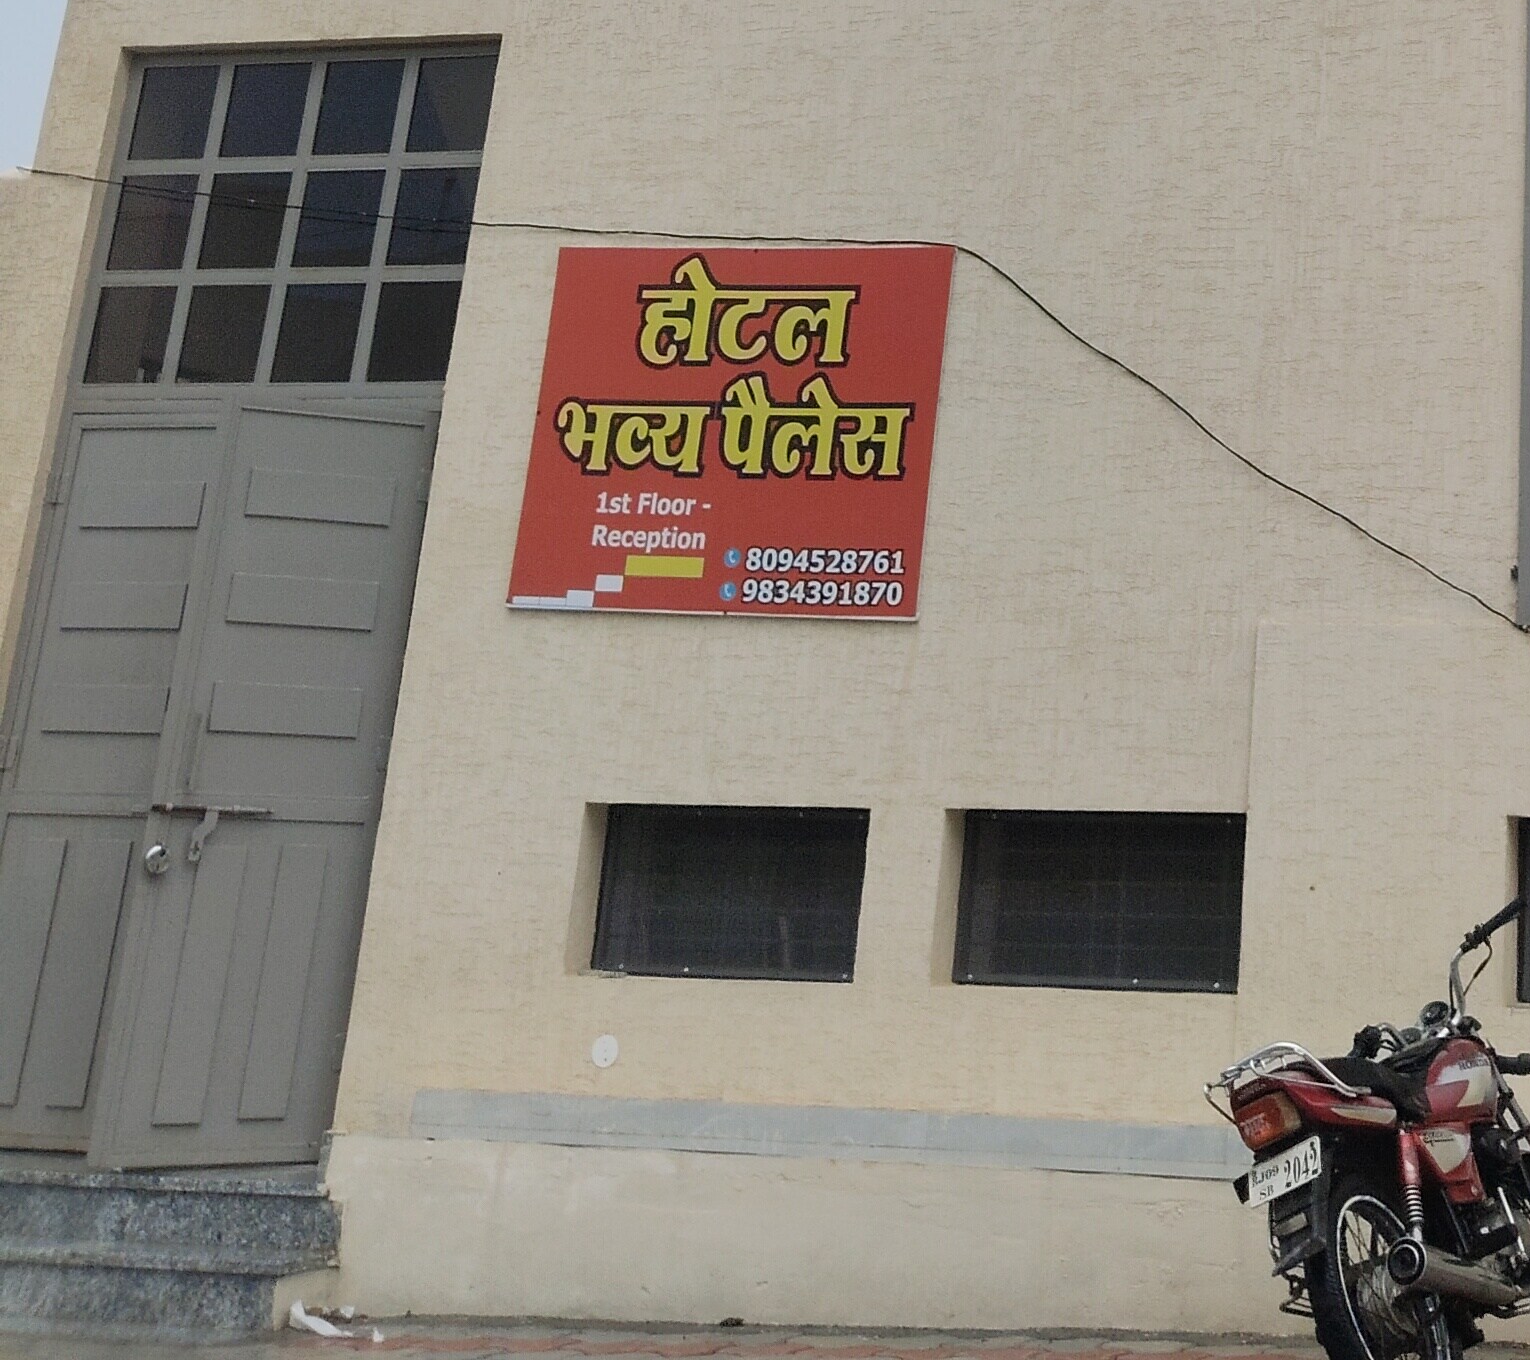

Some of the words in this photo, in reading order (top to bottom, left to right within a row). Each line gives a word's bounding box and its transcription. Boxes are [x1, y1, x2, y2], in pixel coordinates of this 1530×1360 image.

[638, 254, 860, 368] होटल
[554, 396, 714, 477] भव्य
[717, 371, 915, 479] पैलेस
[596, 492, 631, 515] 1st
[637, 493, 697, 516] Floor
[592, 524, 706, 553] Reception
[745, 548, 904, 575] 8094528761
[742, 581, 902, 606] 9834391870
[1283, 1141, 1319, 1188] 2042
